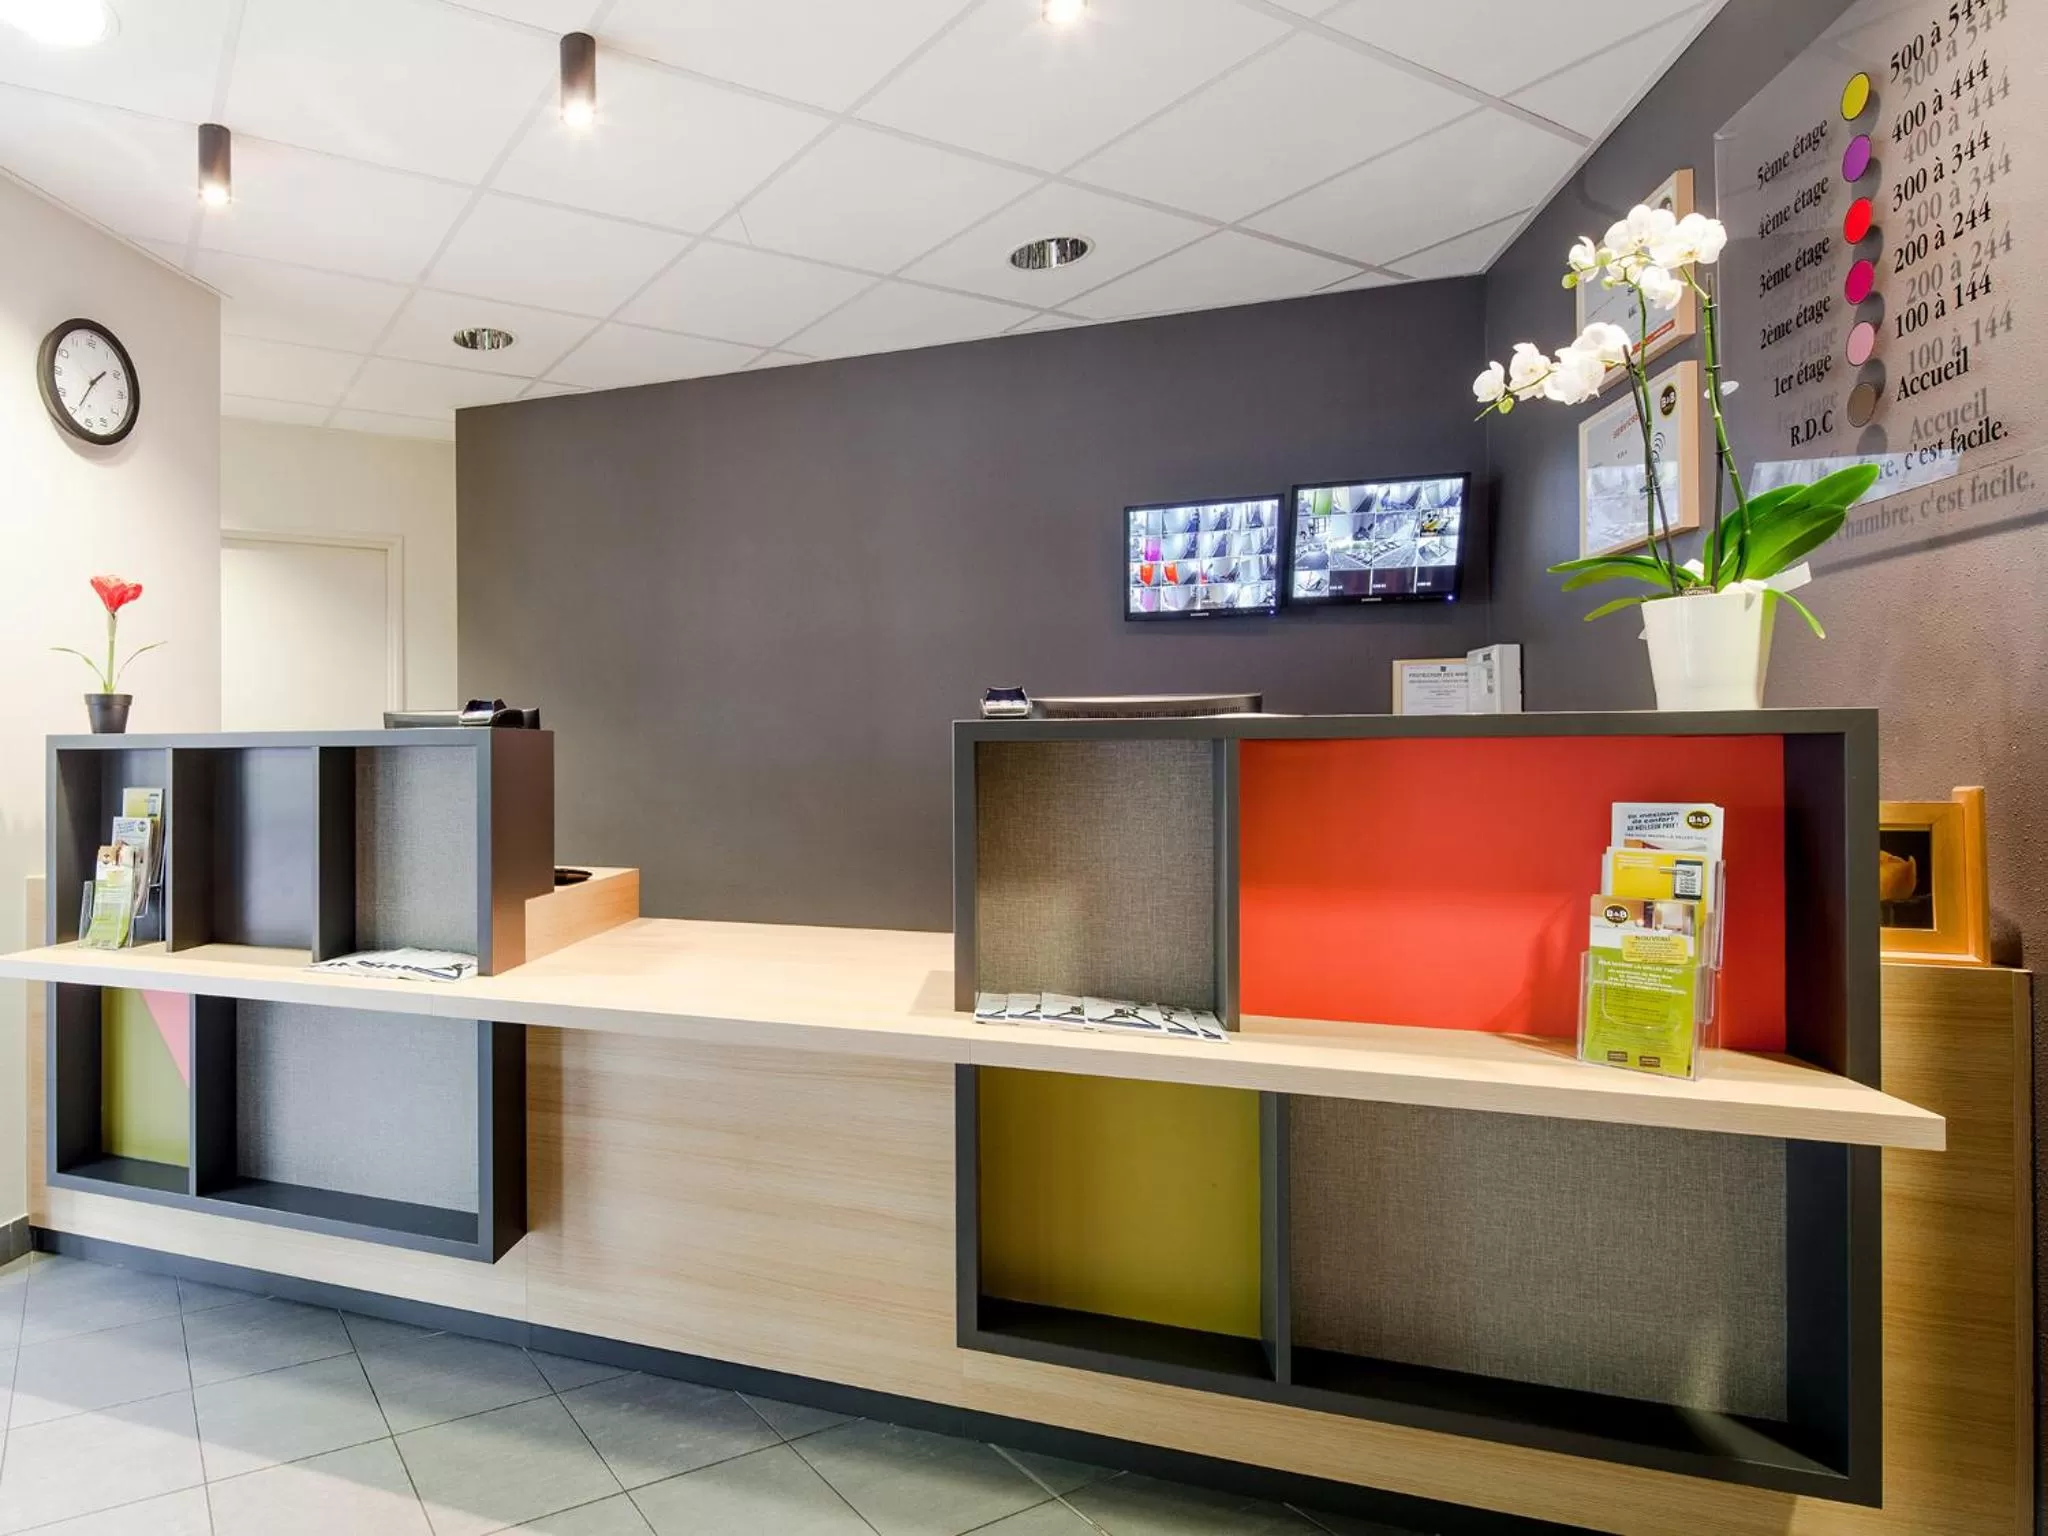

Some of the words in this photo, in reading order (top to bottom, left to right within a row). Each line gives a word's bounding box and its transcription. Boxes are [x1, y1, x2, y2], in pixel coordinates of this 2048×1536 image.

[1890, 34, 1925, 84] 500
[1930, 21, 1942, 48] à
[1892, 101, 1926, 144] 400
[1932, 88, 1943, 116] à
[1950, 50, 1989, 100] 444
[1757, 150, 1790, 190] 5ème
[1793, 120, 1828, 159] étage
[1893, 168, 1927, 212] 300
[1933, 156, 1945, 183] à
[1951, 119, 1991, 174] 344
[1758, 205, 1791, 240] 4ème
[1793, 176, 1829, 213] étage
[1894, 233, 1928, 274] 200
[1934, 223, 1946, 250] à
[1952, 191, 1991, 240] 244
[1759, 261, 1792, 299] 3ème
[1794, 236, 1830, 272] étage
[1760, 316, 1793, 349] 2ème
[1796, 295, 1831, 329] étage
[1894, 301, 1928, 339] 100
[1934, 292, 1946, 320] à
[1952, 264, 1991, 310] 144
[1774, 373, 1794, 397] 1er
[1797, 354, 1832, 386] étage
[1896, 346, 1969, 402] Accueil
[1790, 410, 1834, 448] R.D.C
[1904, 437, 1945, 471] c'est
[1950, 416, 2009, 455] facile.
